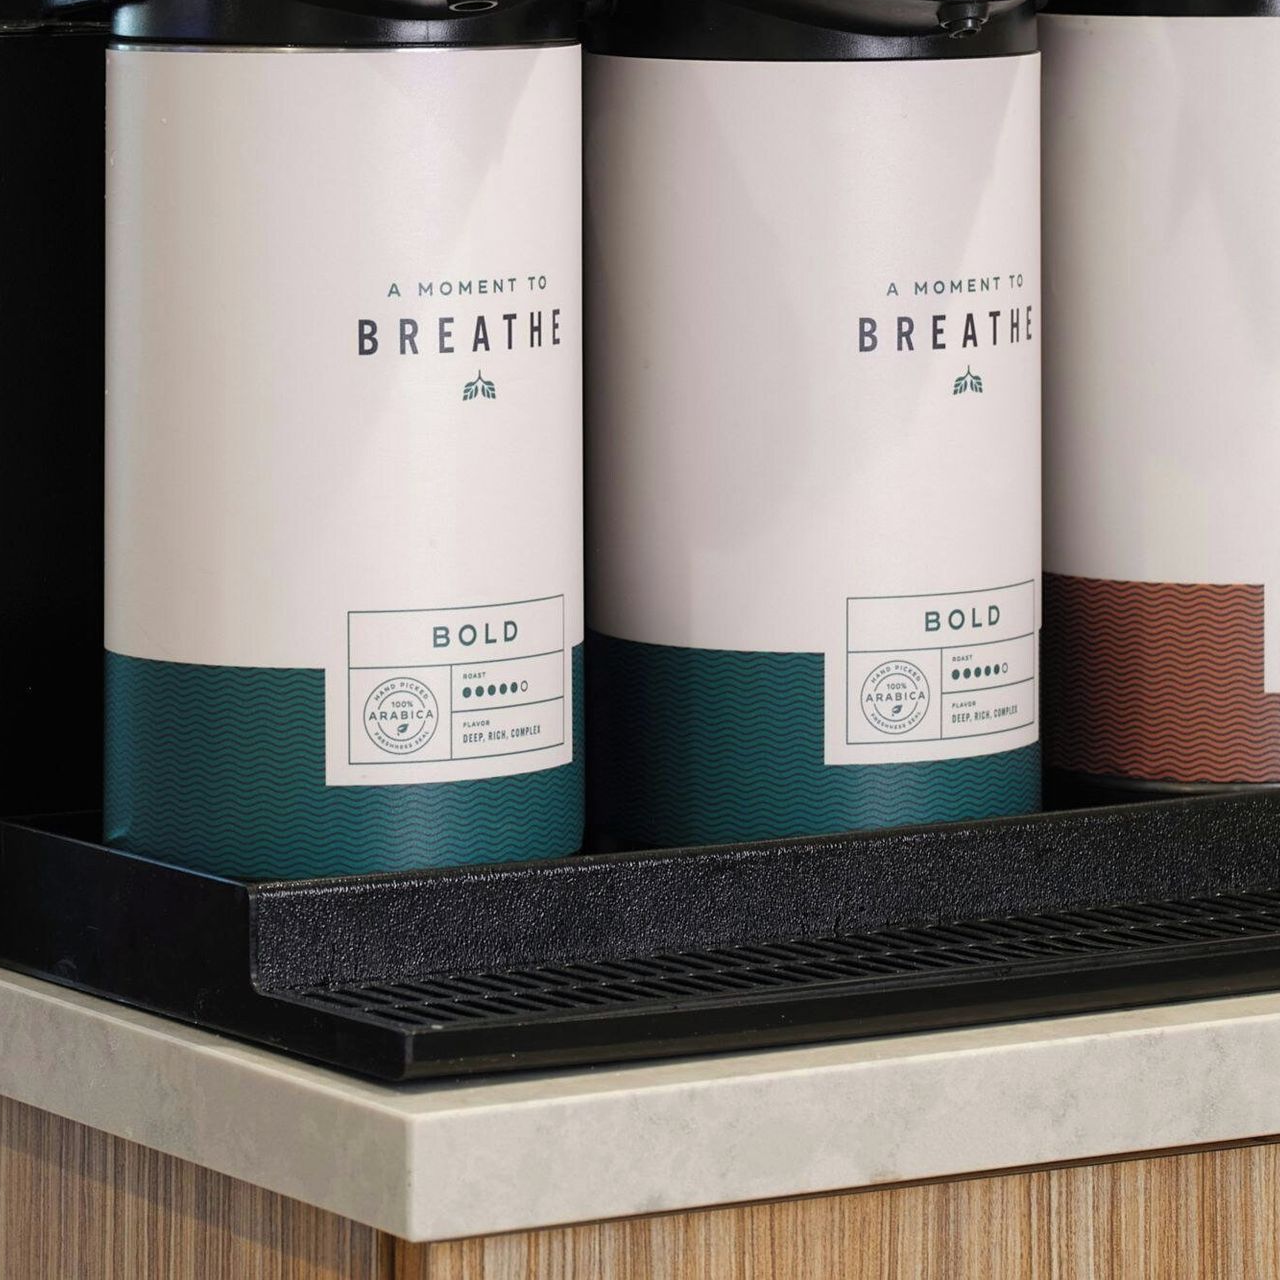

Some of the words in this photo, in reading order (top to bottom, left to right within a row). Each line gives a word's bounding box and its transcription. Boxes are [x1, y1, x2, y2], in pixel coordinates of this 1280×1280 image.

[387, 282, 401, 297] A
[418, 277, 517, 297] MOMENT
[528, 275, 547, 291] TO
[886, 282, 899, 297] A
[914, 276, 1000, 295] MOMENT
[1009, 273, 1024, 288] TO
[358, 308, 561, 356] BREATHE
[858, 305, 1032, 352] BREATHE
[924, 605, 1000, 632] BOLD
[432, 620, 518, 648] BOLD
[952, 654, 973, 662] ROAST
[463, 671, 486, 680] ROAST
[871, 666, 891, 684] HAND
[895, 664, 921, 682] PICKED
[374, 683, 396, 701] HAND
[400, 682, 429, 700] PICKED
[865, 691, 926, 703] ARABICA
[391, 700, 413, 708] 100%
[952, 700, 976, 709] FLAVOR
[368, 709, 434, 721] ARABICA
[463, 720, 490, 728] FLAVOR
[463, 732, 486, 744] DEEP,
[488, 729, 509, 741] RICH,
[511, 724, 541, 738] COMPLEX
